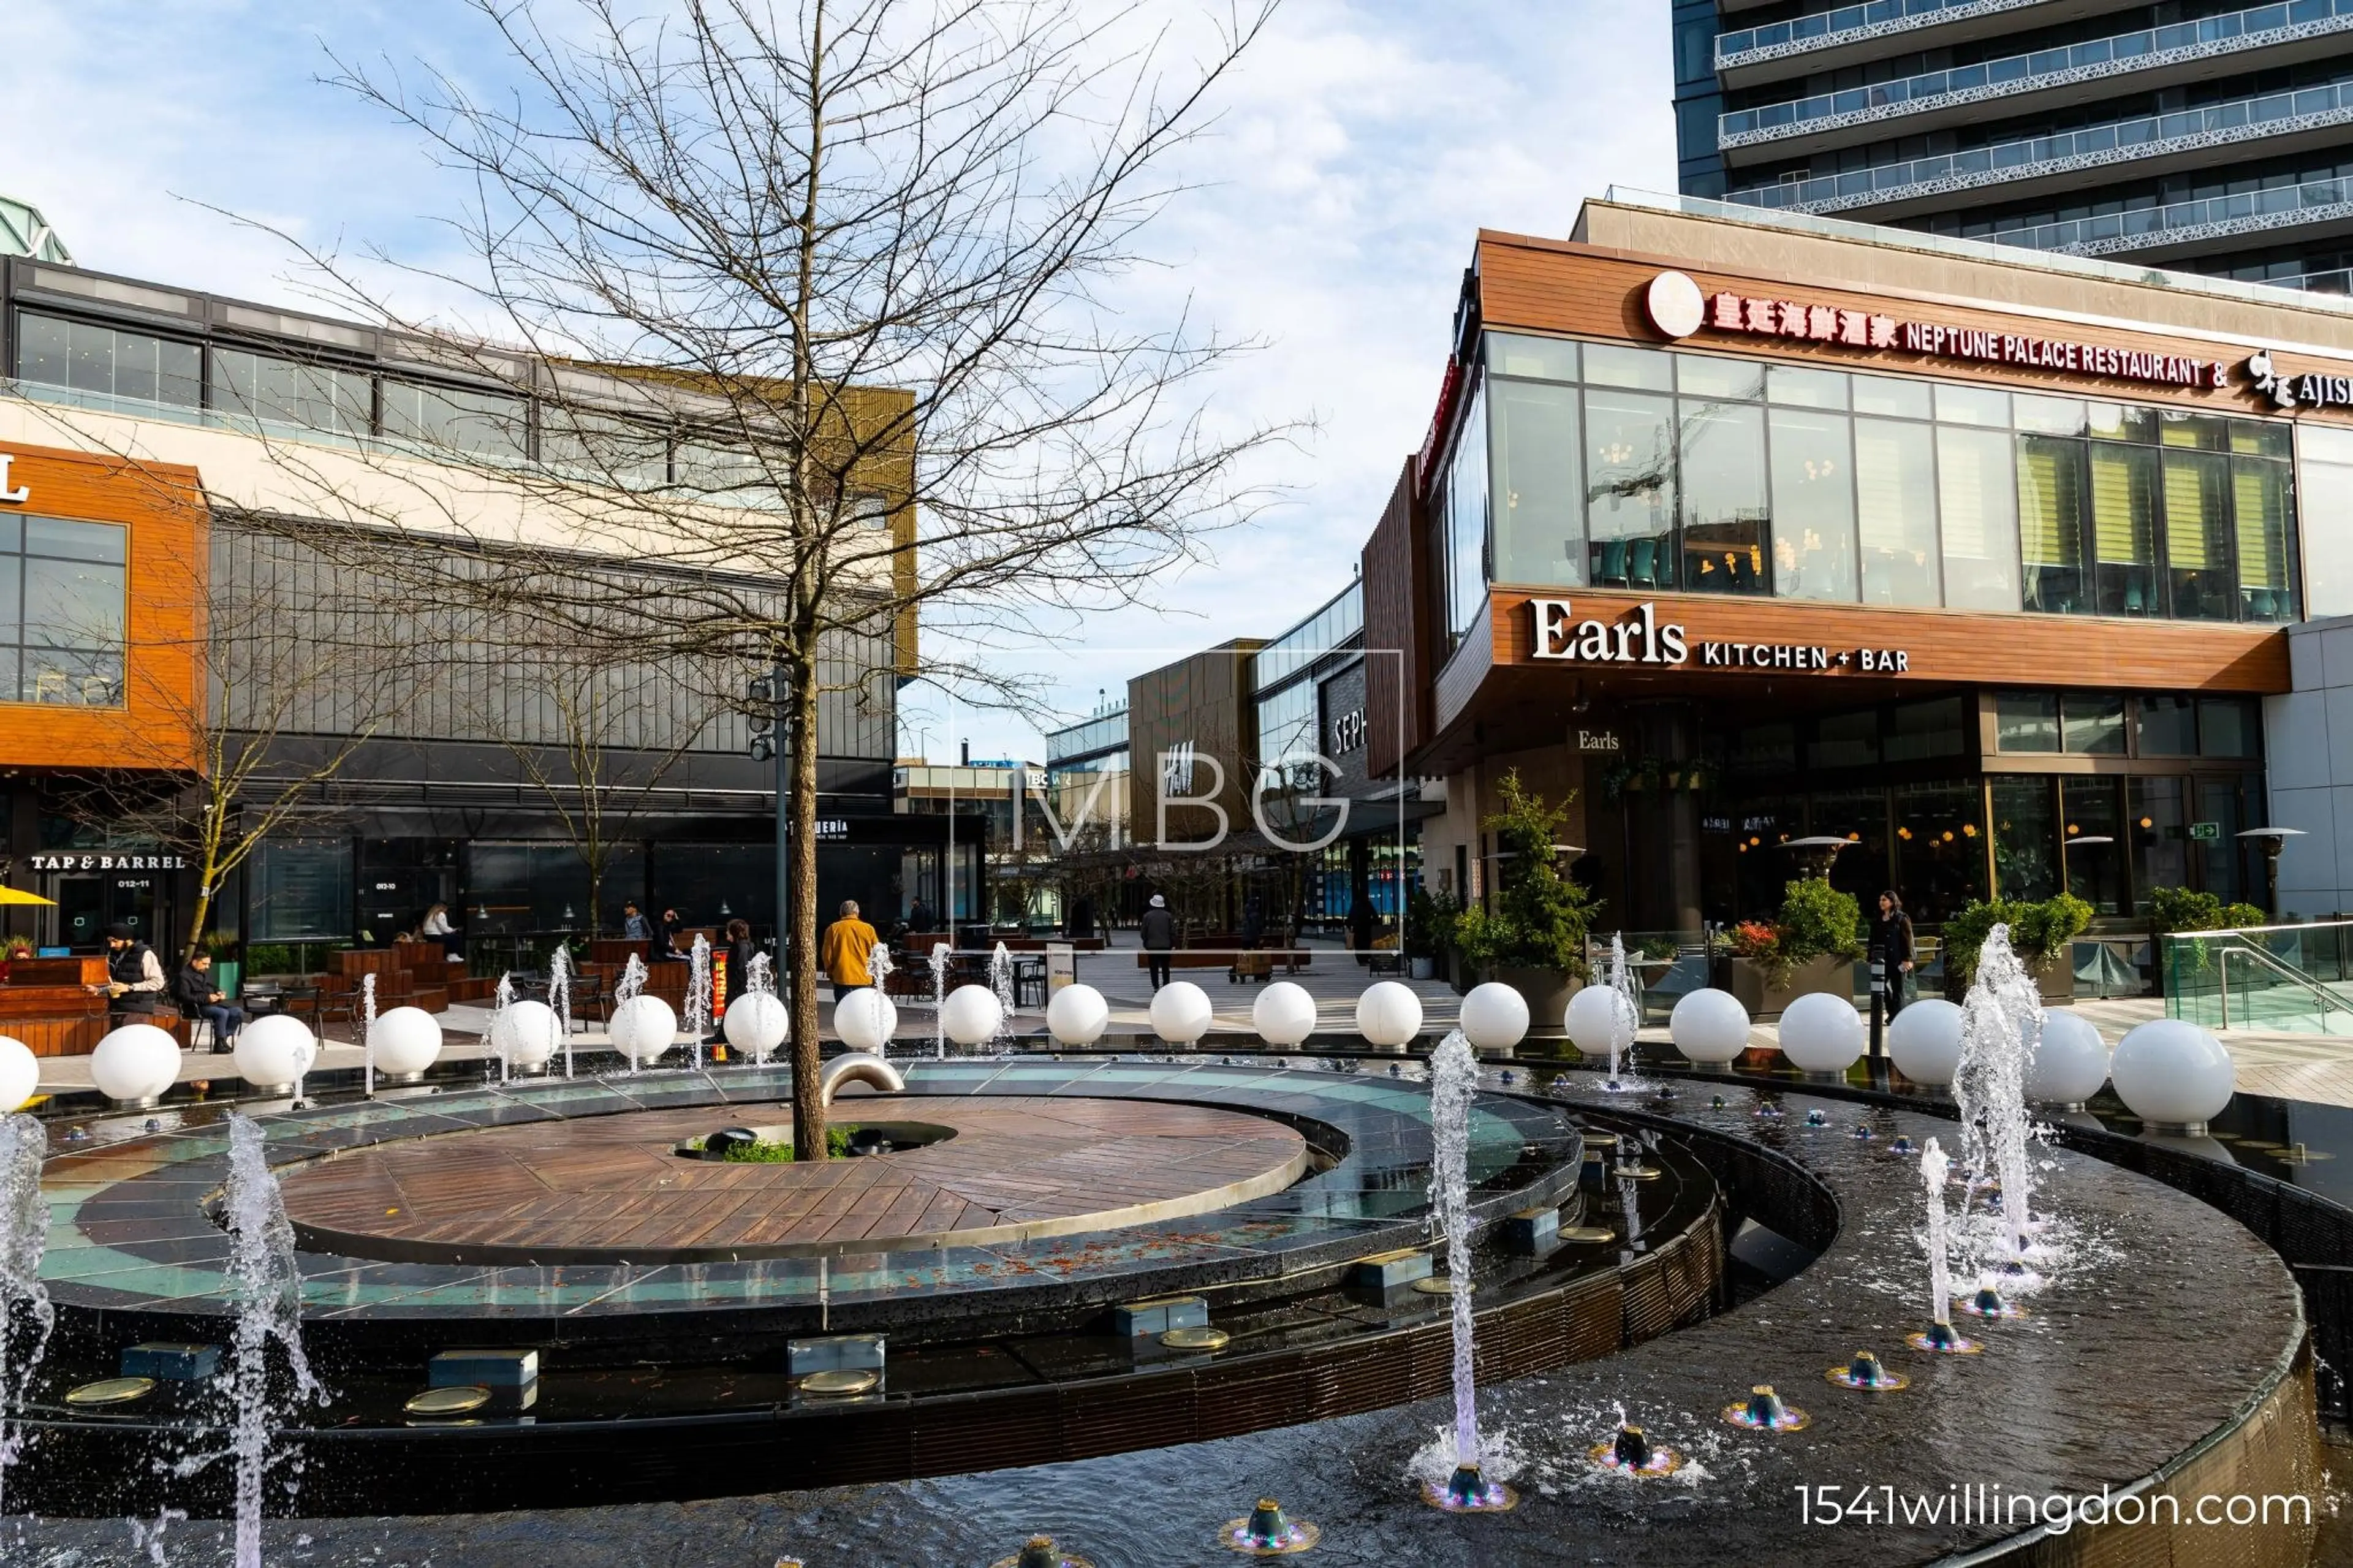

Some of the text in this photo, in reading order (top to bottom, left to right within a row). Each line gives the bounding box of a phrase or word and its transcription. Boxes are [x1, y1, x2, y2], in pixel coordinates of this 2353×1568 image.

[1907, 322, 2228, 387] NEPTUNE PALACE RESTAURANT &
[1531, 599, 1909, 672] Earls KITCHEN + BAR
[1579, 730, 1619, 749] Earls
[32, 856, 186, 869] TAP & BARREL
